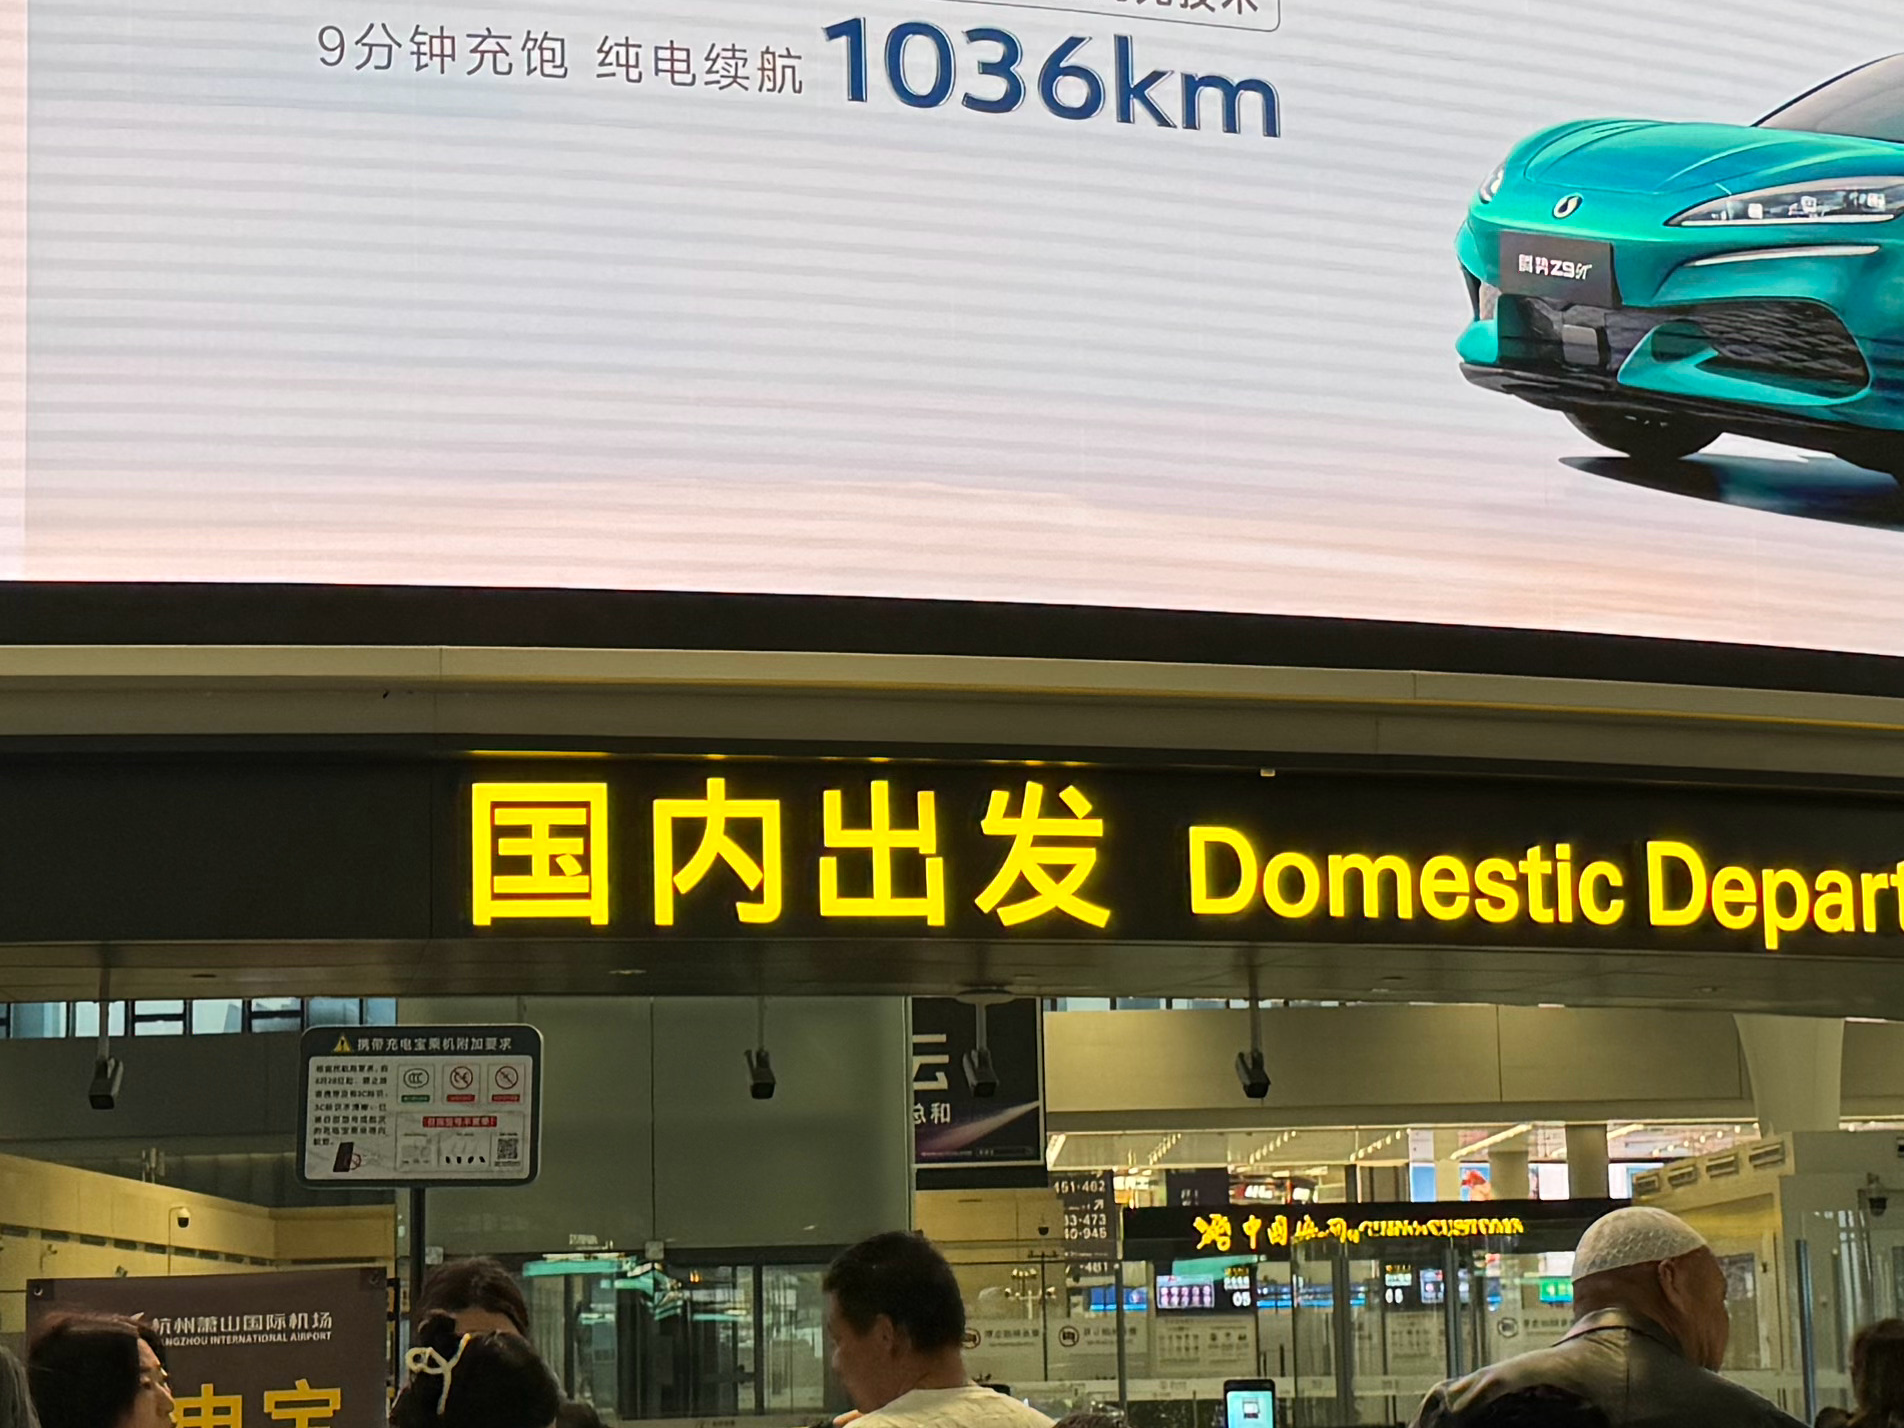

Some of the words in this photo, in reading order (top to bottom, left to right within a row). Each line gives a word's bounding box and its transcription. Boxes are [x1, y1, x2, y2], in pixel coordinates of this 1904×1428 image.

[316, 23, 570, 80] 9分钟充饱
[594, 31, 805, 95] 纯电续航
[823, 17, 1282, 141] 1036km
[471, 778, 1112, 929] 国内出发
[1189, 823, 1625, 930] Domestic
[210, 1333, 287, 1345] INTERNATIONAL
[290, 1331, 331, 1342] AIRPORT
